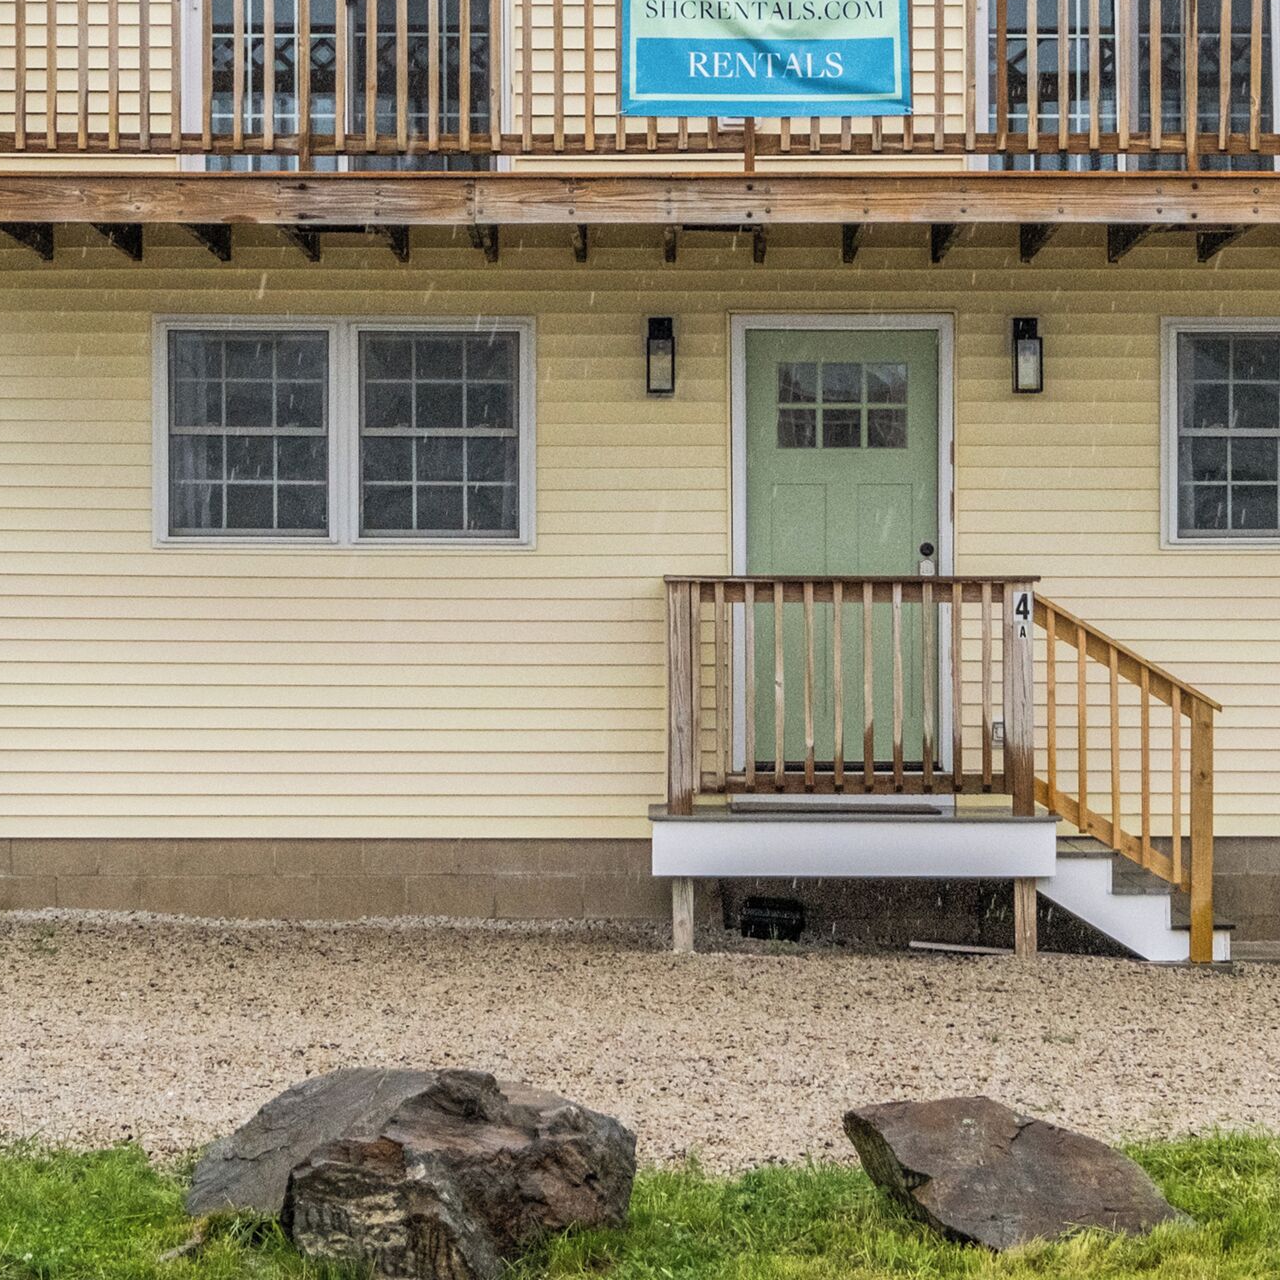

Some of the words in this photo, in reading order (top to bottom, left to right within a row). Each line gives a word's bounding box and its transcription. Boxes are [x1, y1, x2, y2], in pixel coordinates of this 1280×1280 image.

[645, 0, 883, 20] SHCRENTALS.COM
[688, 51, 843, 78] RENTALS
[1015, 593, 1030, 620] 4
[1019, 625, 1027, 638] A
